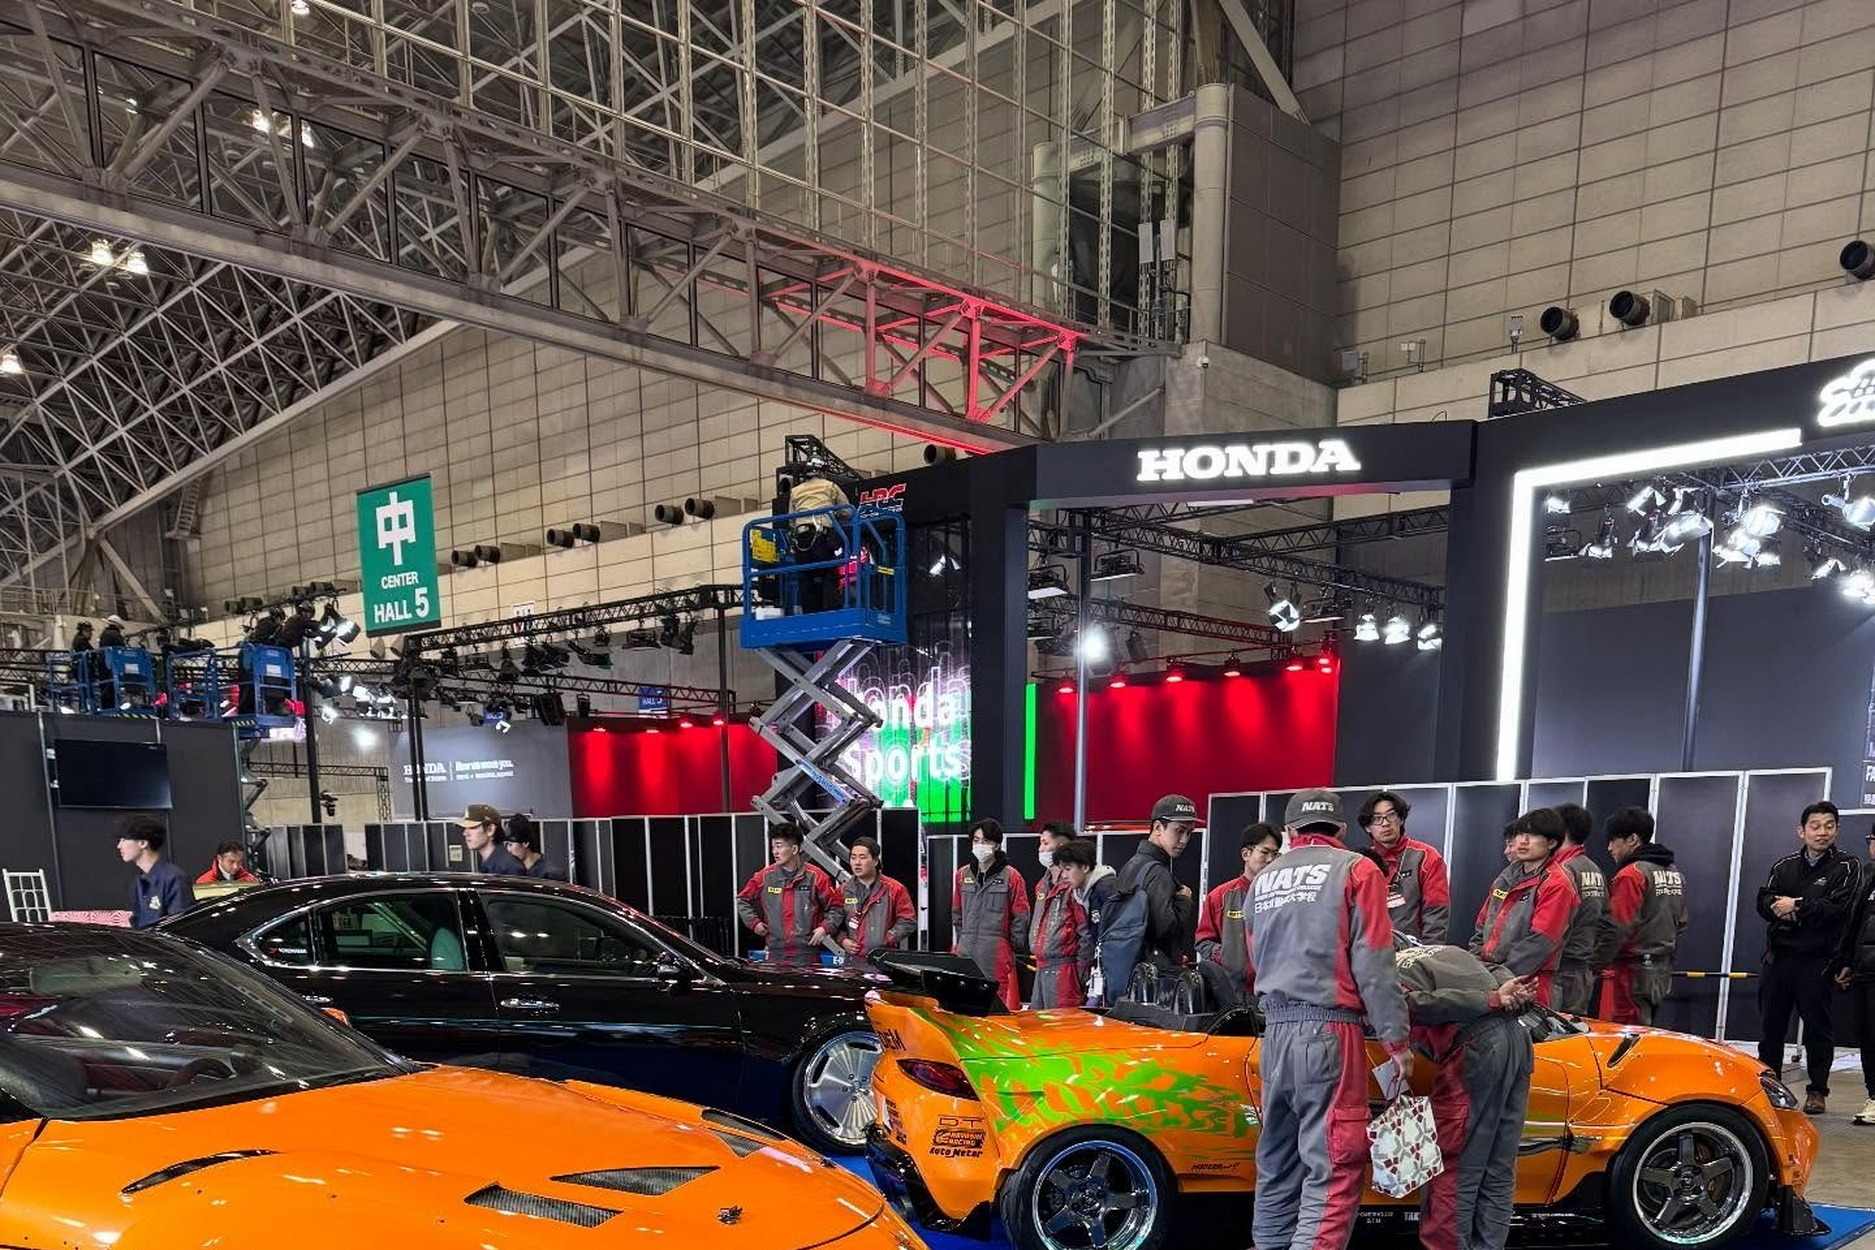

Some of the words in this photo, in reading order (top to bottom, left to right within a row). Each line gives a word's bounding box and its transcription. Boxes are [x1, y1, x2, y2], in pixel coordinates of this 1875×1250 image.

[1136, 438, 1362, 482] HONDA
[375, 491, 417, 566] 中
[381, 571, 419, 589] CENTER
[373, 599, 412, 623] HALL
[414, 586, 430, 618] 5
[403, 762, 447, 775] HNDA
[1301, 801, 1334, 812] NATS
[1254, 864, 1332, 897] NATS
[1581, 872, 1604, 886] NAT
